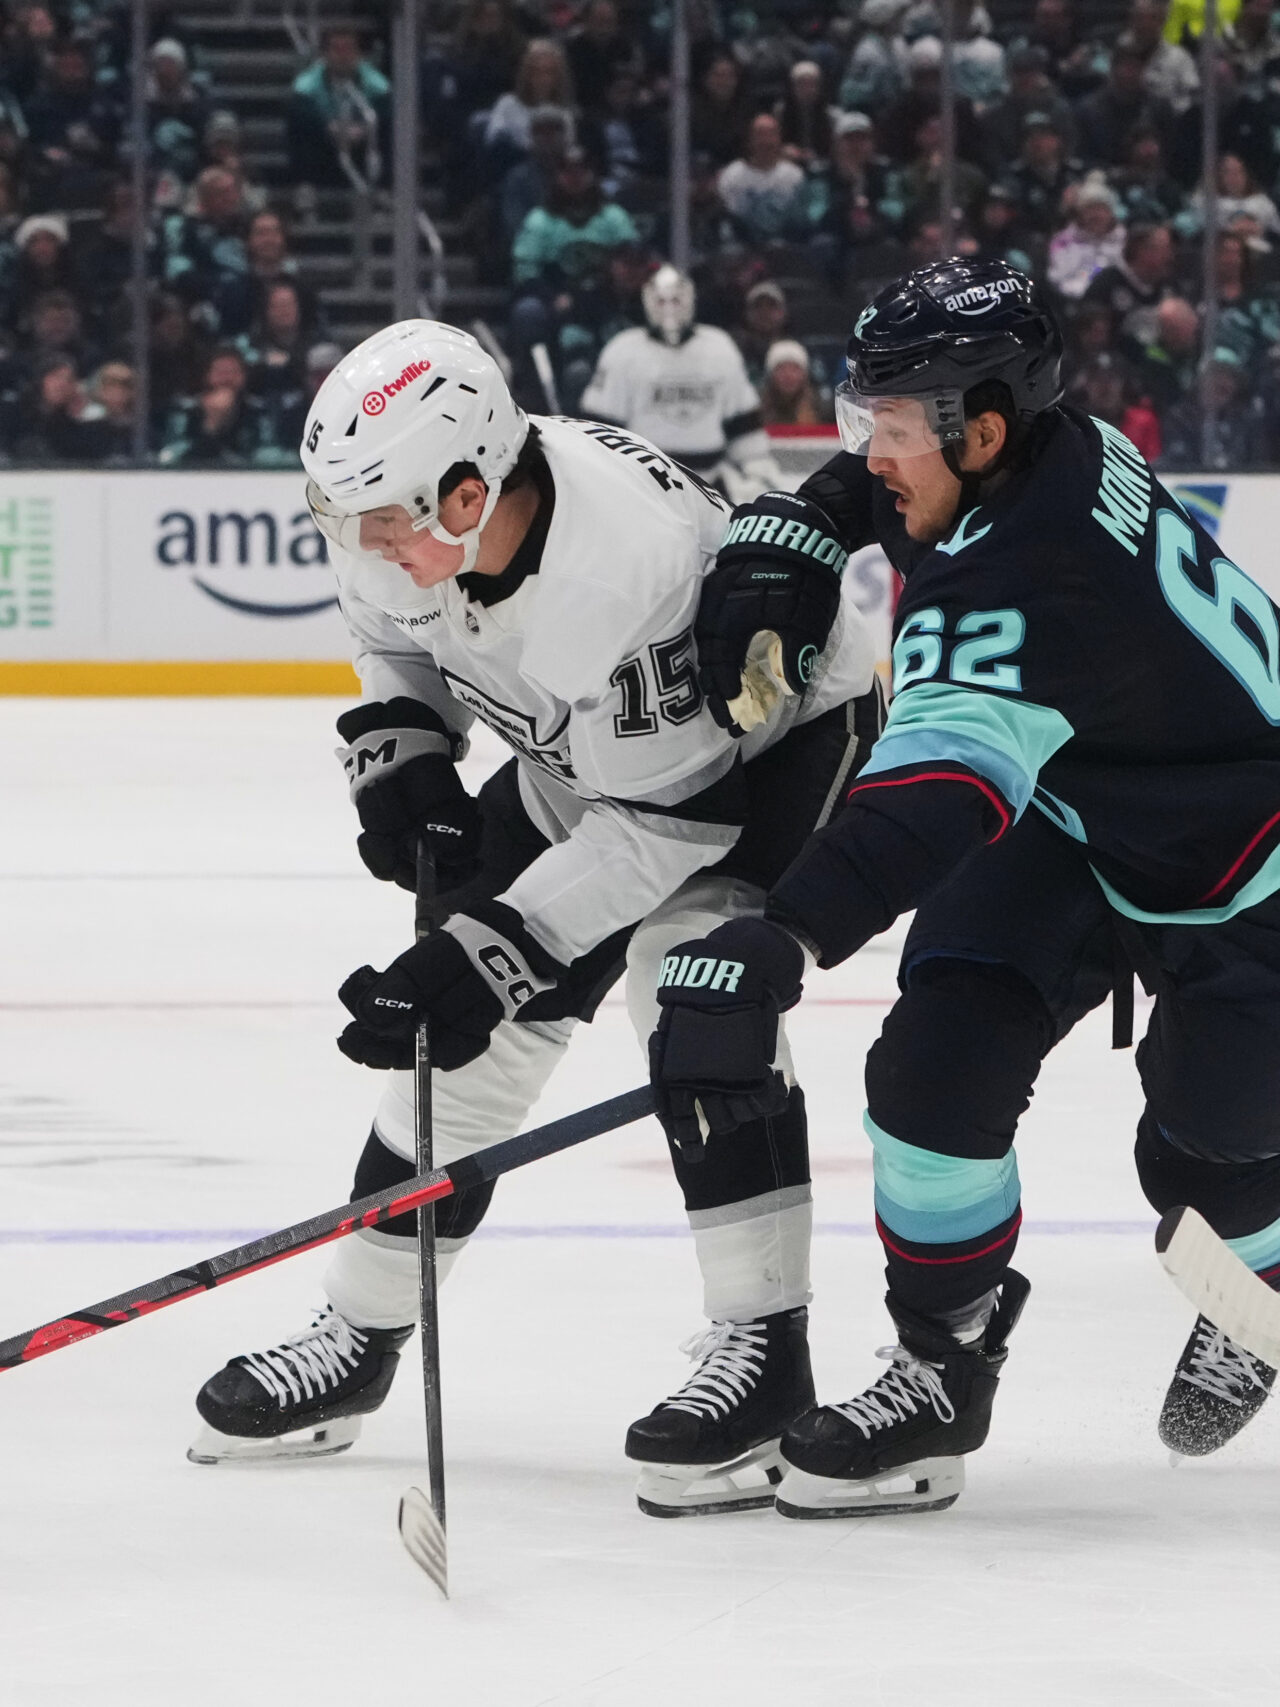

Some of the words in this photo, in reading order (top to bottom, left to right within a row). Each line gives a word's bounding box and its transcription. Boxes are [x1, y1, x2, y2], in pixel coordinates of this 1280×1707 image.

[944, 277, 1024, 312] amazon
[383, 359, 432, 398] twilio
[157, 510, 328, 567] ama
[751, 572, 791, 580] COVERT
[408, 608, 442, 627] BOW
[892, 605, 1027, 697] 62
[609, 623, 706, 738] 15
[426, 823, 464, 837] CCM
[374, 997, 413, 1011] CCM
